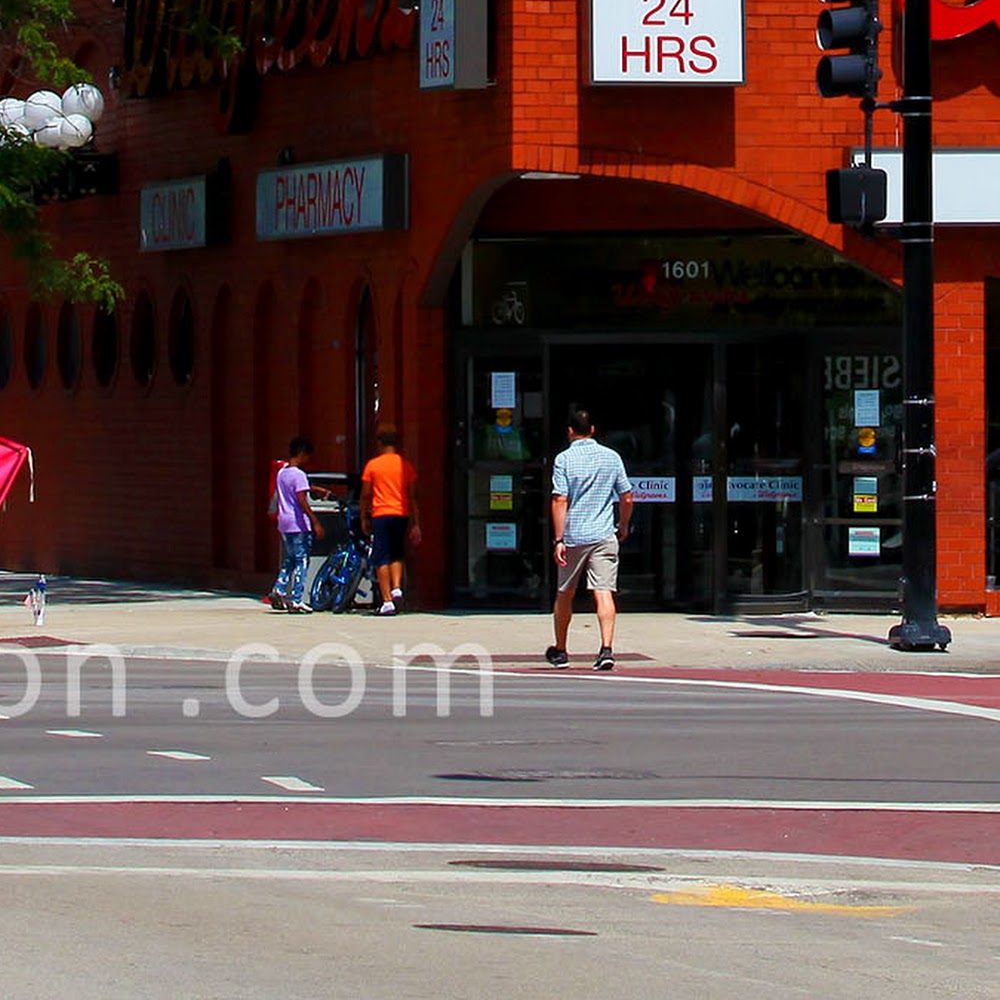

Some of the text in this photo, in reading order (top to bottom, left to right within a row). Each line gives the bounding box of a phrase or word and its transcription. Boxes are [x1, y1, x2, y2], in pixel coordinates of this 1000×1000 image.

[425, 40, 450, 79] HRS
[621, 35, 718, 75] HRS
[274, 166, 365, 231] PHARMACY
[662, 261, 710, 279] 1601
[639, 481, 670, 490] Clinic
